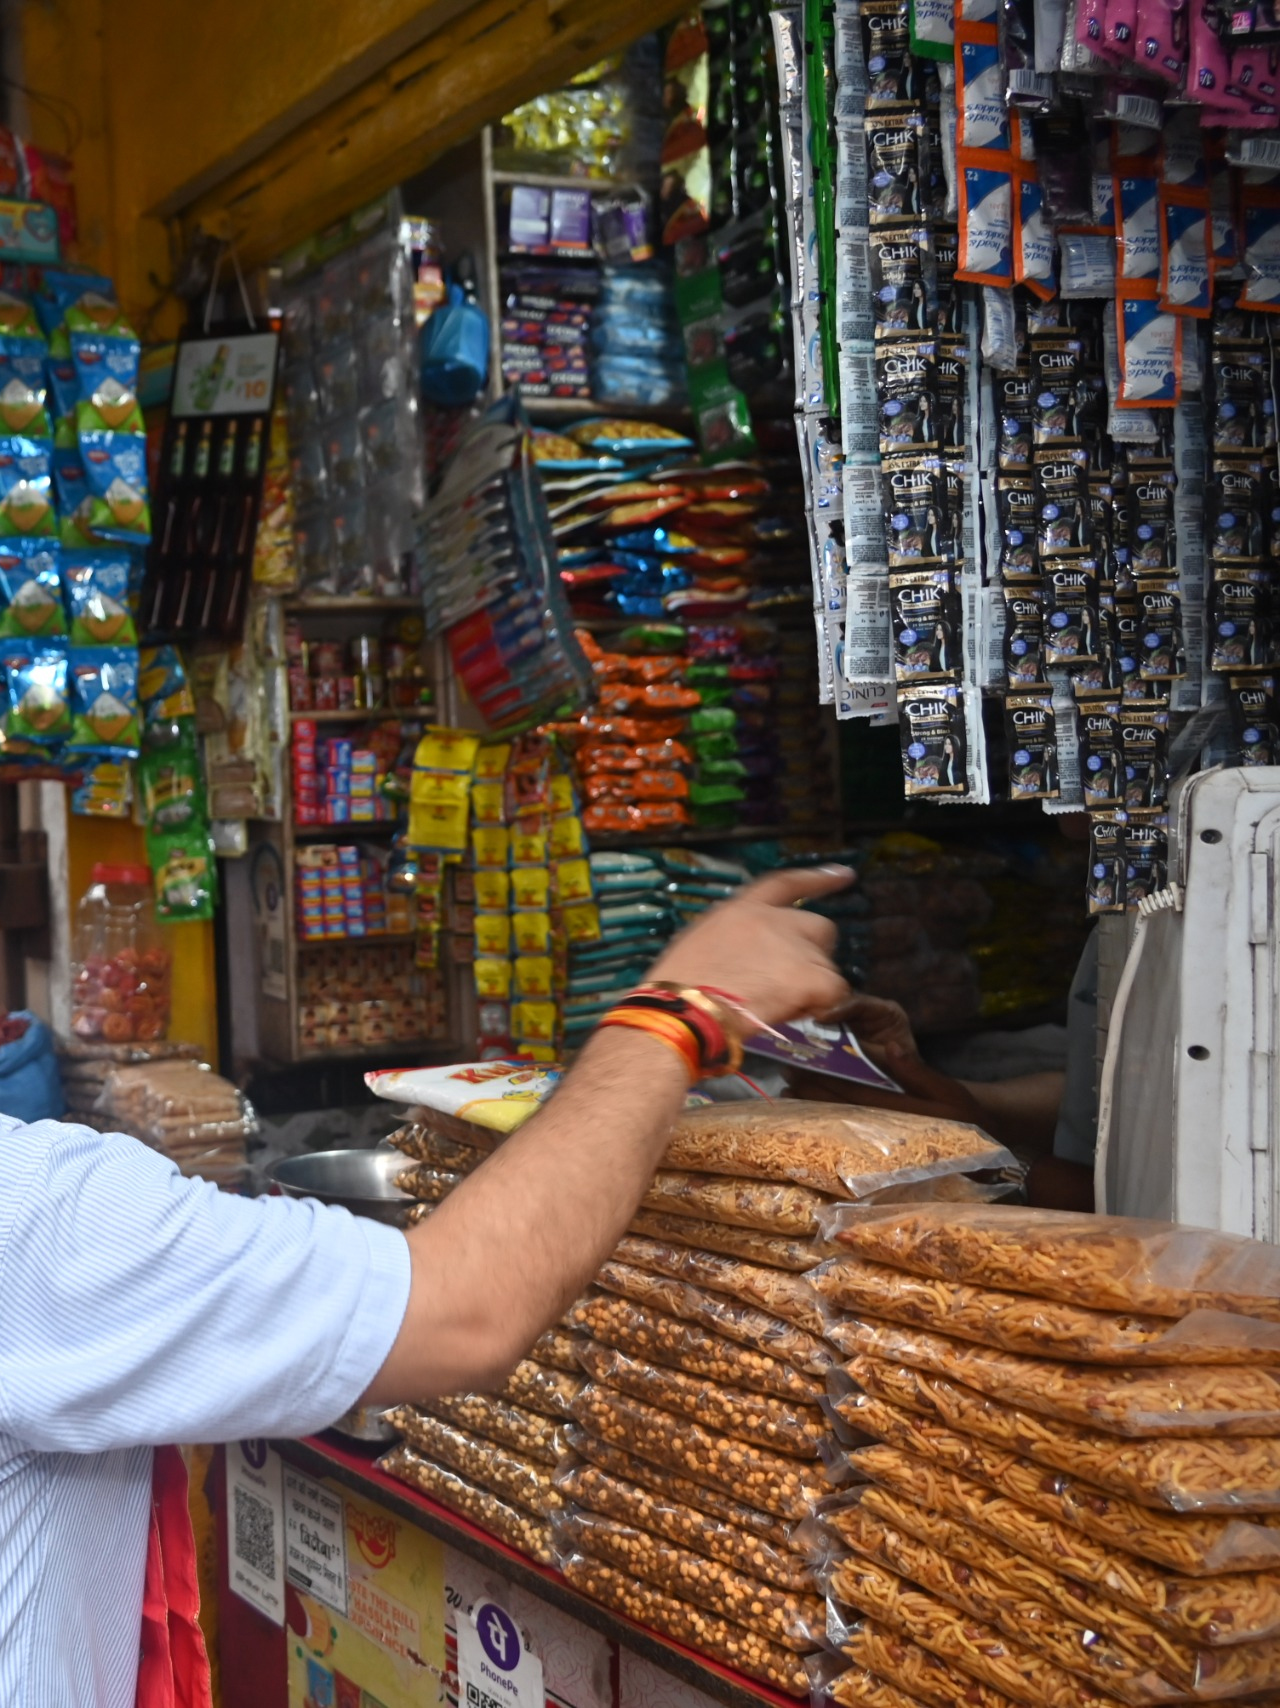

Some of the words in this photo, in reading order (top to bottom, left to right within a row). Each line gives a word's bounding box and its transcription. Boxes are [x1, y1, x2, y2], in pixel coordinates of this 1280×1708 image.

[868, 16, 908, 31] CHIK
[873, 130, 915, 147] CHIK
[878, 246, 918, 260] CHIK
[884, 358, 928, 374] CHIK
[1039, 353, 1076, 368] CHIK
[1221, 365, 1253, 381] CHIK
[1041, 464, 1078, 480] CHIK
[891, 472, 932, 488] CHIK
[1221, 474, 1253, 489] CHIK
[1136, 486, 1167, 500] CHIK
[1053, 572, 1088, 587] CHIK
[898, 588, 941, 603] CHIK
[1222, 583, 1254, 598] CHIK
[1013, 601, 1040, 615] CHIK
[1143, 594, 1175, 608] CHIK
[841, 686, 886, 700] CLINIC
[906, 702, 949, 717] CHIK
[1013, 711, 1046, 725] CHIK
[1087, 717, 1113, 731] CHIK
[1122, 727, 1157, 742] CHIK
[1094, 824, 1120, 838] CHIK
[1124, 826, 1158, 841] CHIK
